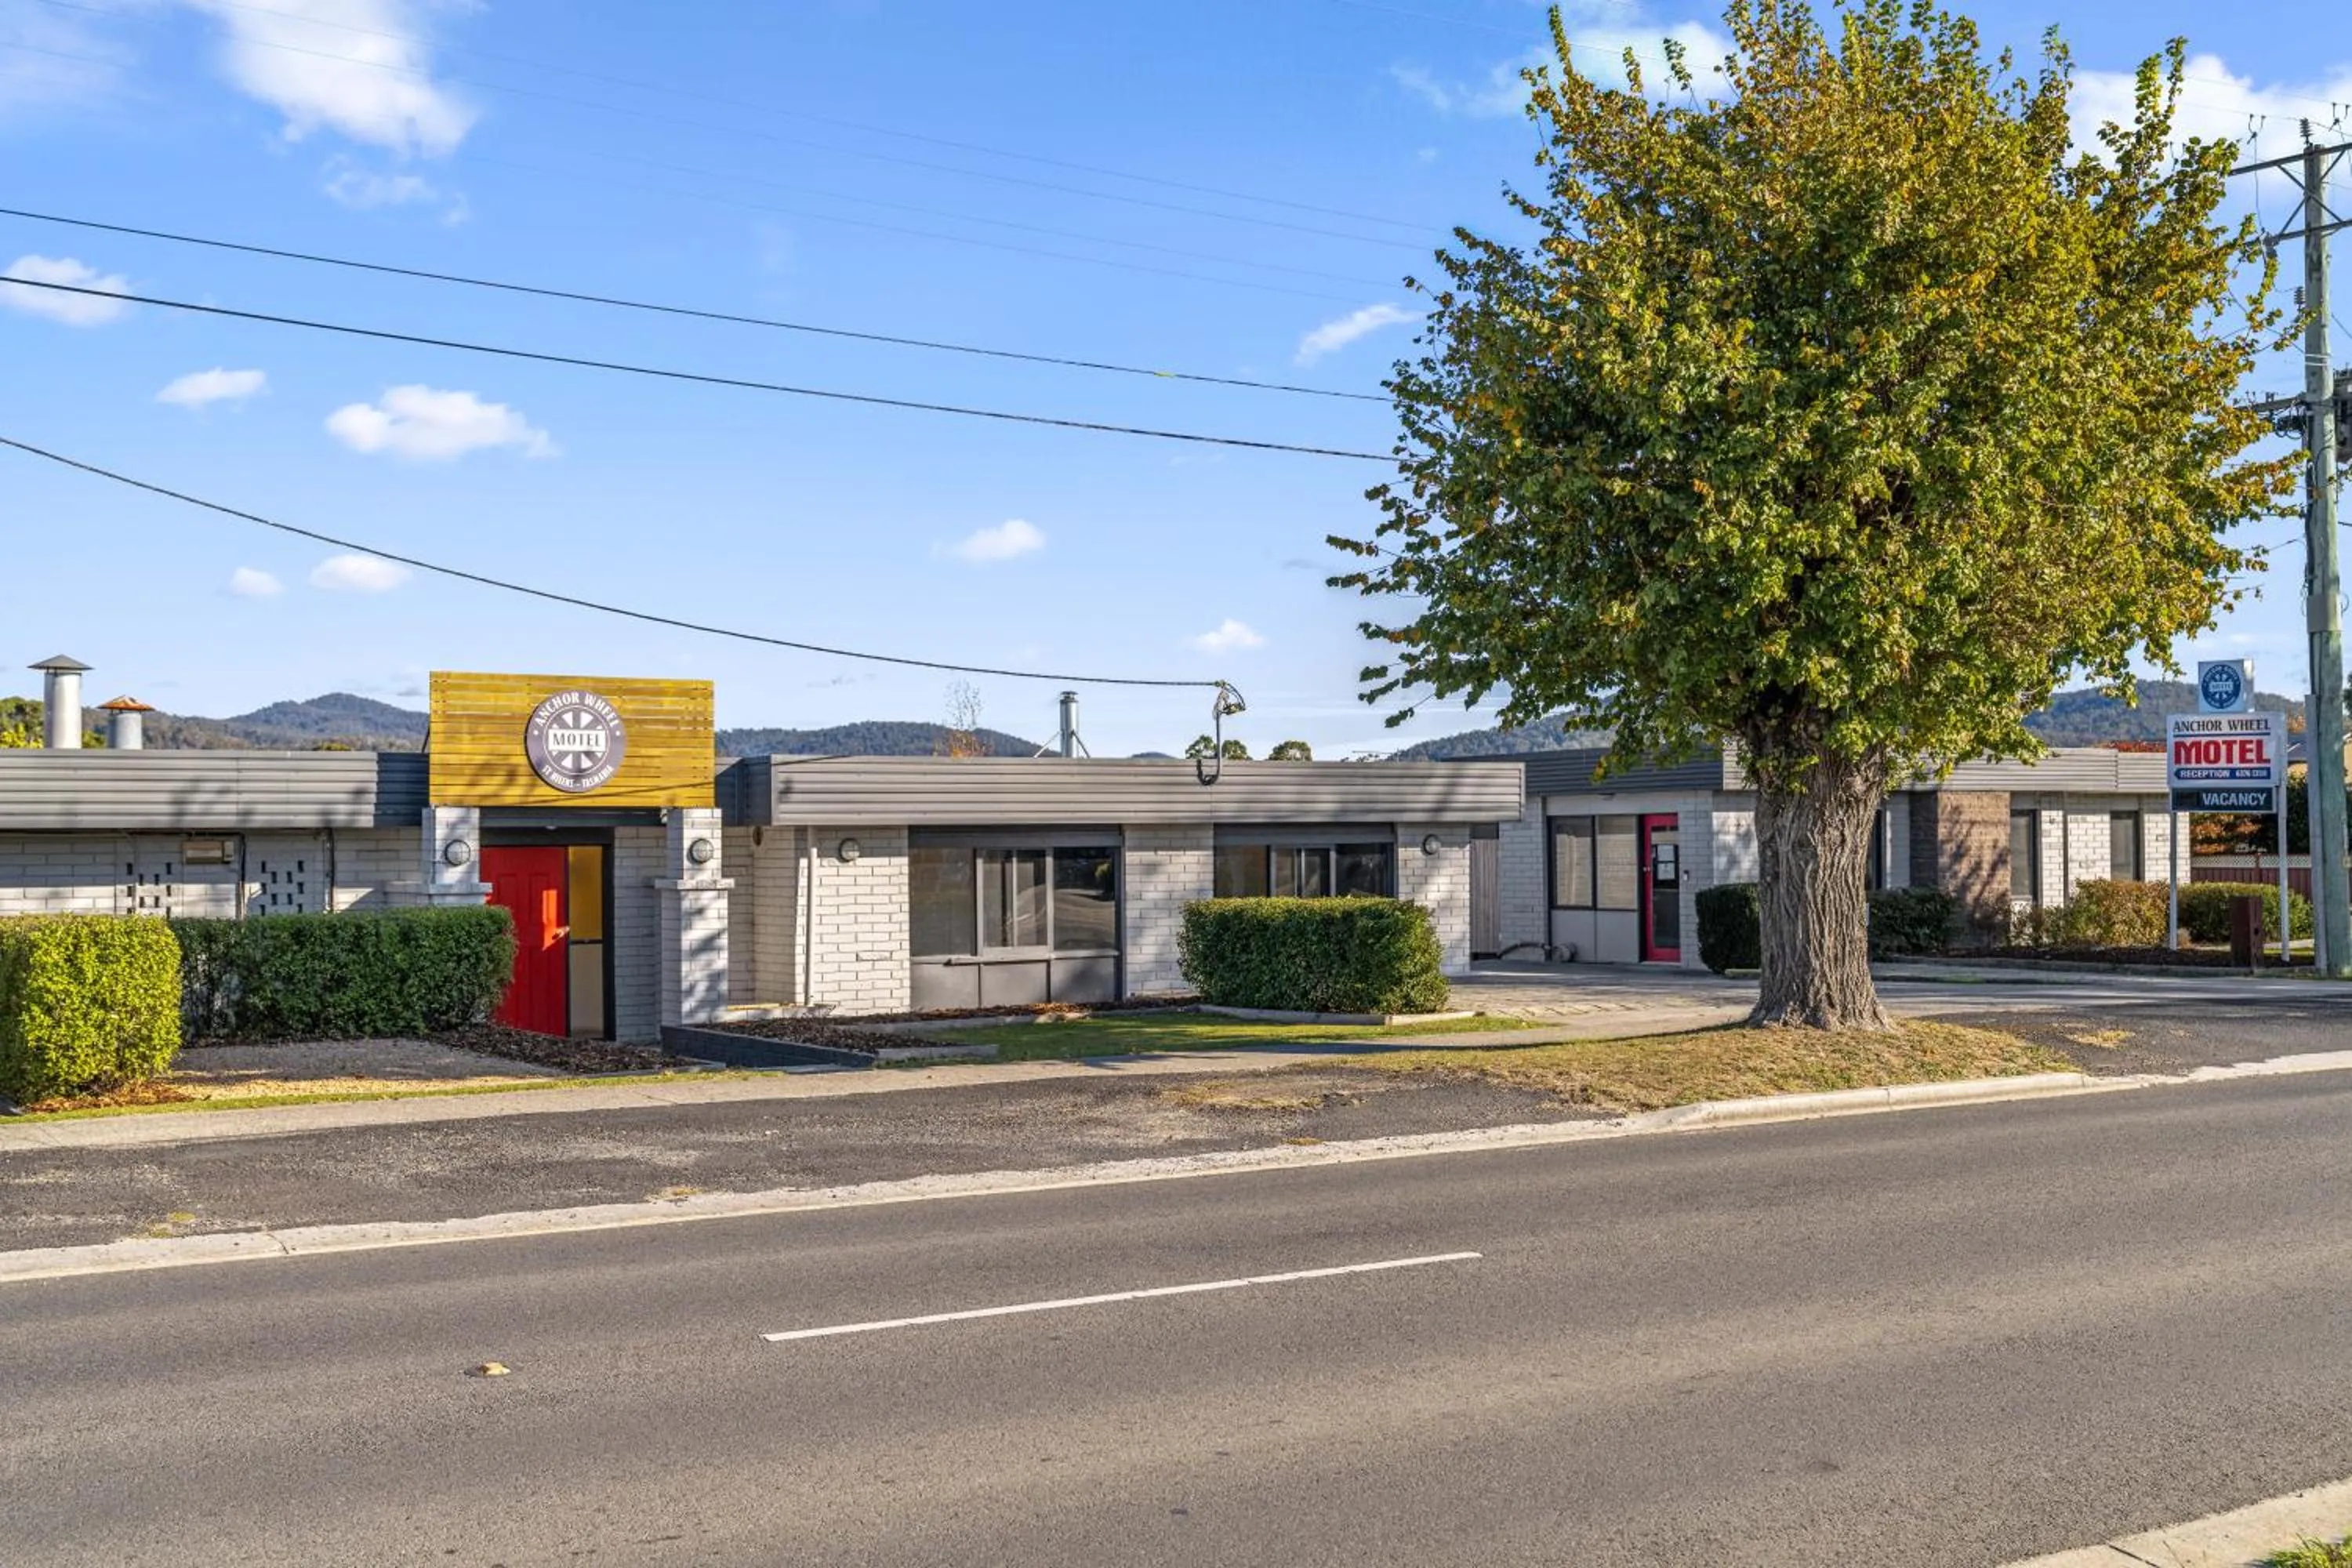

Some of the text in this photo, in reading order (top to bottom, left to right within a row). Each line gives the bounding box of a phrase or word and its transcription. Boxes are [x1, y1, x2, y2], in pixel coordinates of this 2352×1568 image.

[535, 692, 619, 727] ANCHOR WHEEL
[2174, 719, 2270, 731] ANCHOR WHEEL
[553, 733, 600, 746] MOTEL
[2174, 739, 2270, 765] MOTEL
[2180, 769, 2230, 778] RECEPTION
[2202, 793, 2267, 805] VACANCY
